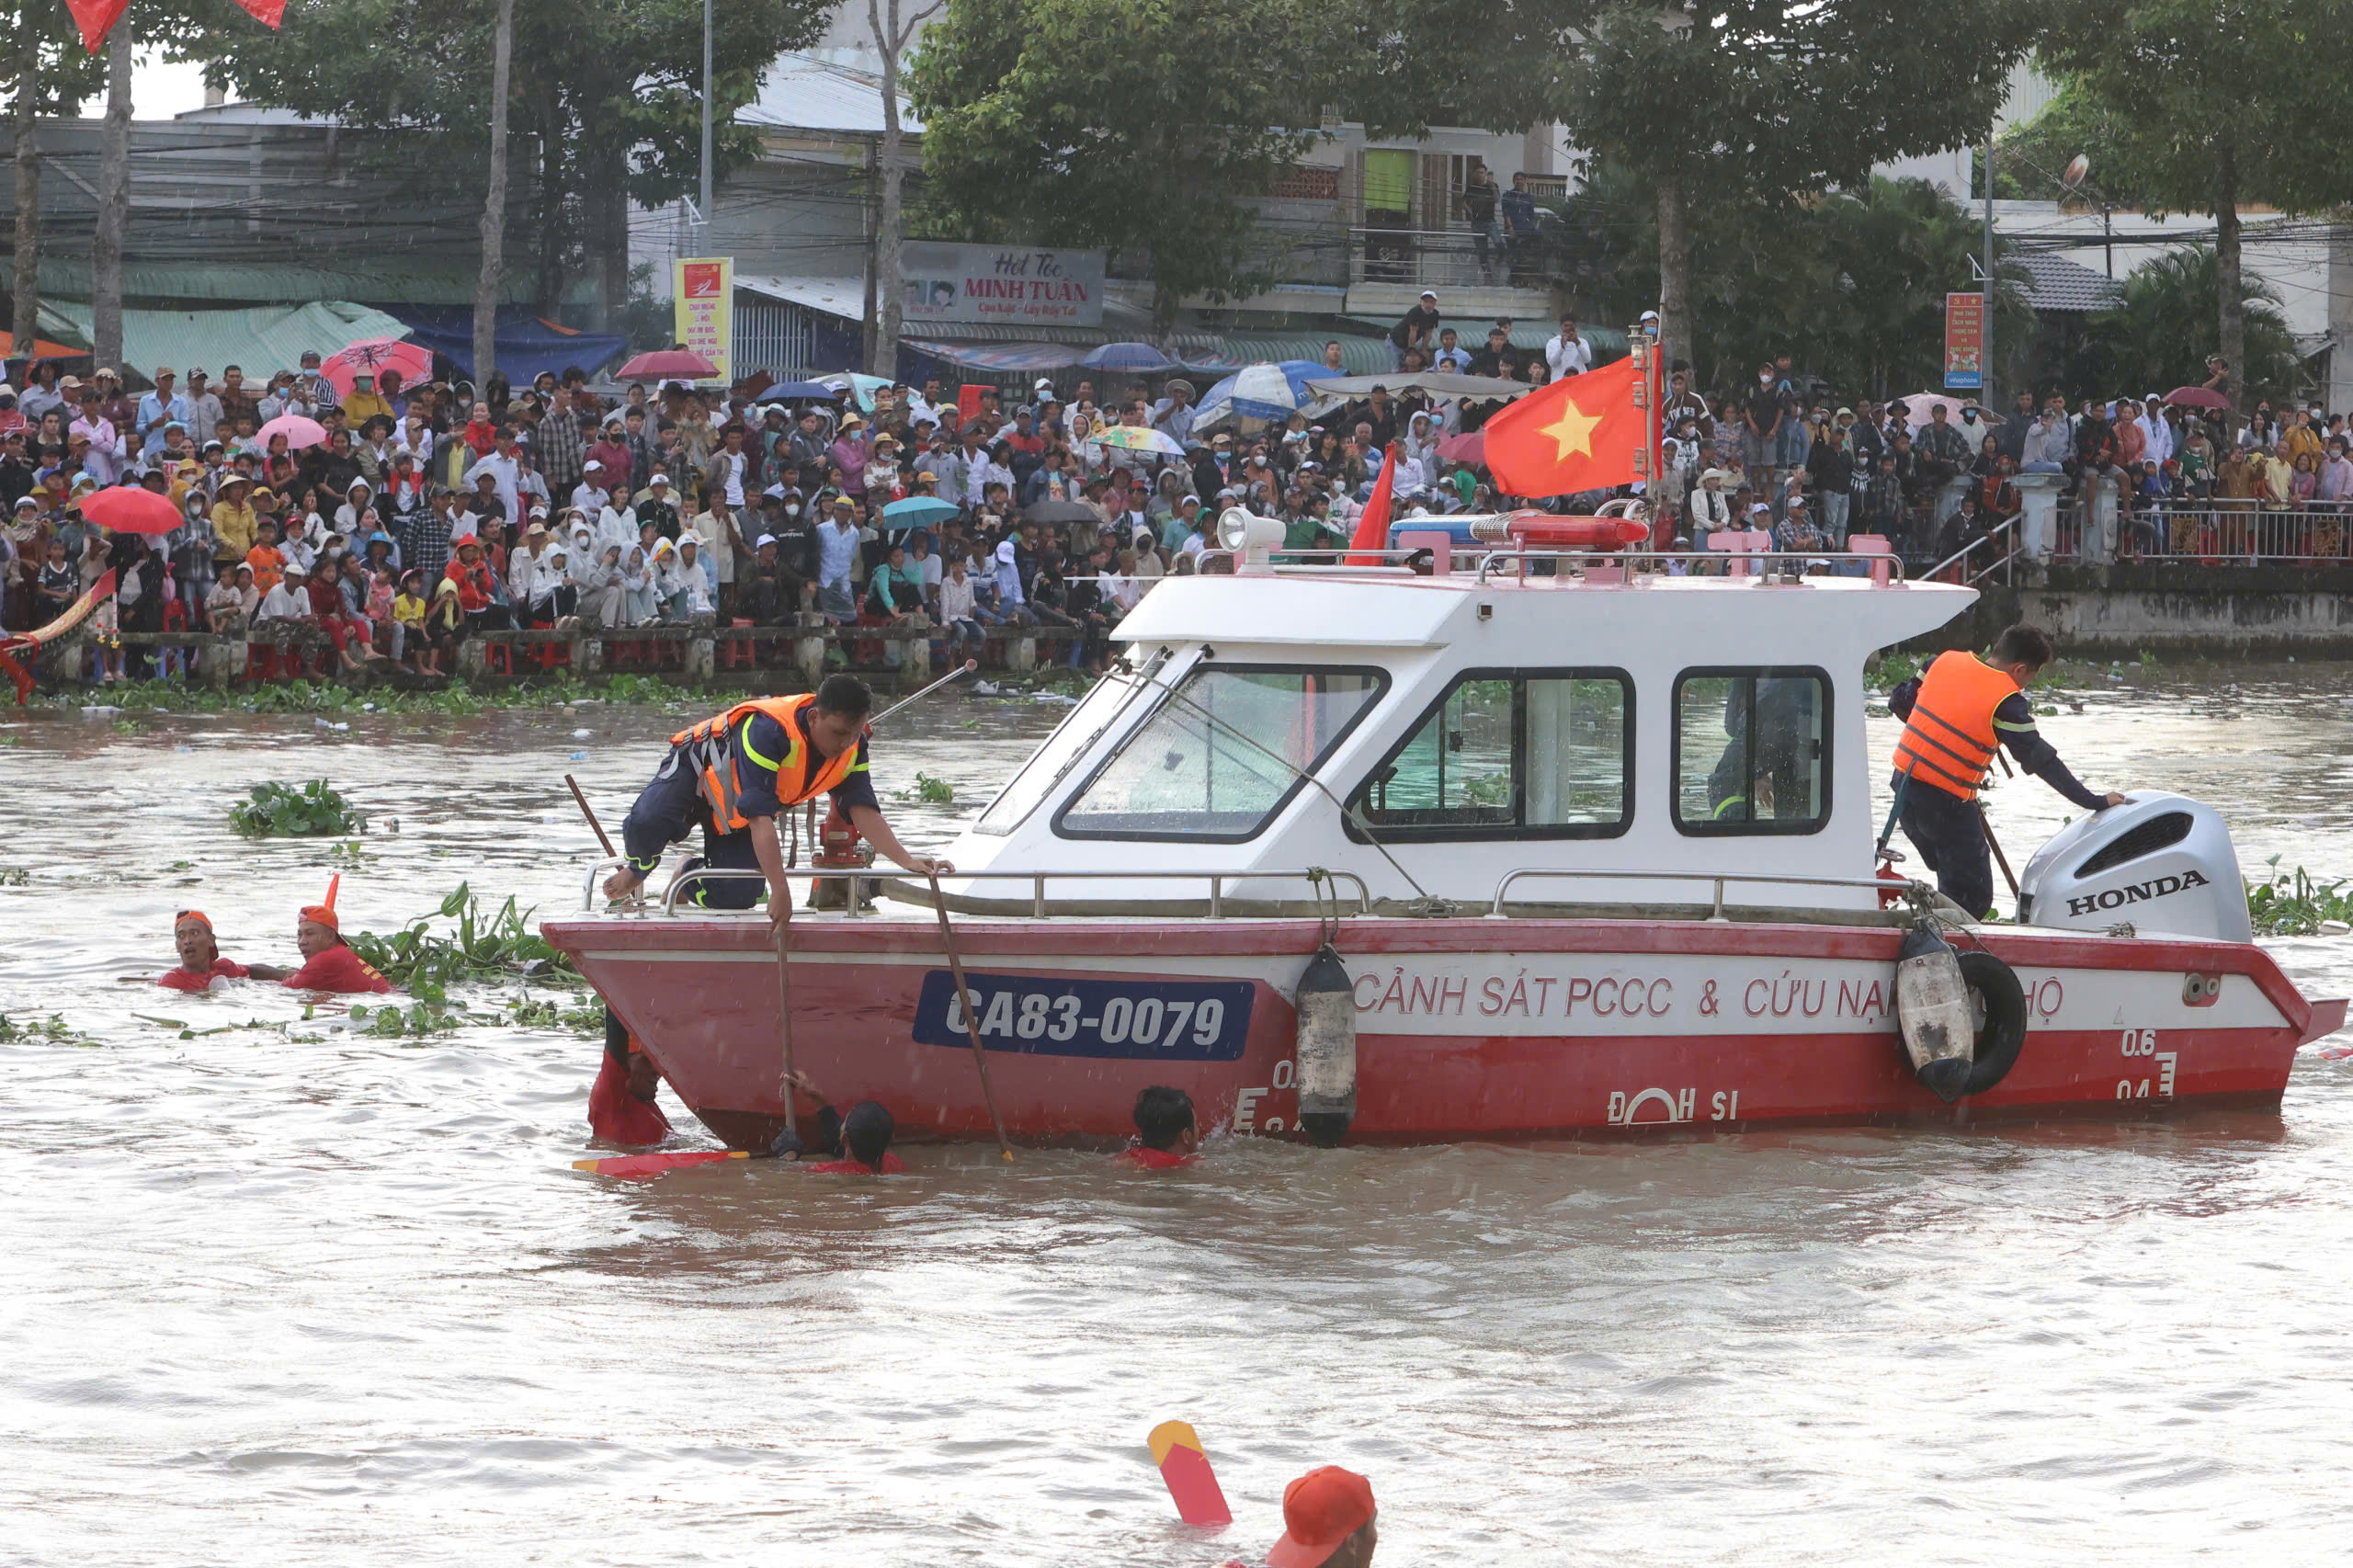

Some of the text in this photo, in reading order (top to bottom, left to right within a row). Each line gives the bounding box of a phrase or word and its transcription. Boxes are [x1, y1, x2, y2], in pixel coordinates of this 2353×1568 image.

[963, 278, 1025, 300] MINH
[2066, 869, 2210, 917] HONDA
[946, 989, 1224, 1047] CA83-0079
[1352, 965, 1468, 1015] CẢNH
[1478, 968, 1558, 1017] SÁT
[1565, 977, 1674, 1017] PCCC
[1698, 978, 1720, 1017] &
[1744, 970, 1826, 1017] CỨU
[1836, 978, 1895, 1024] NẠ
[2121, 1028, 2156, 1057] 0.6
